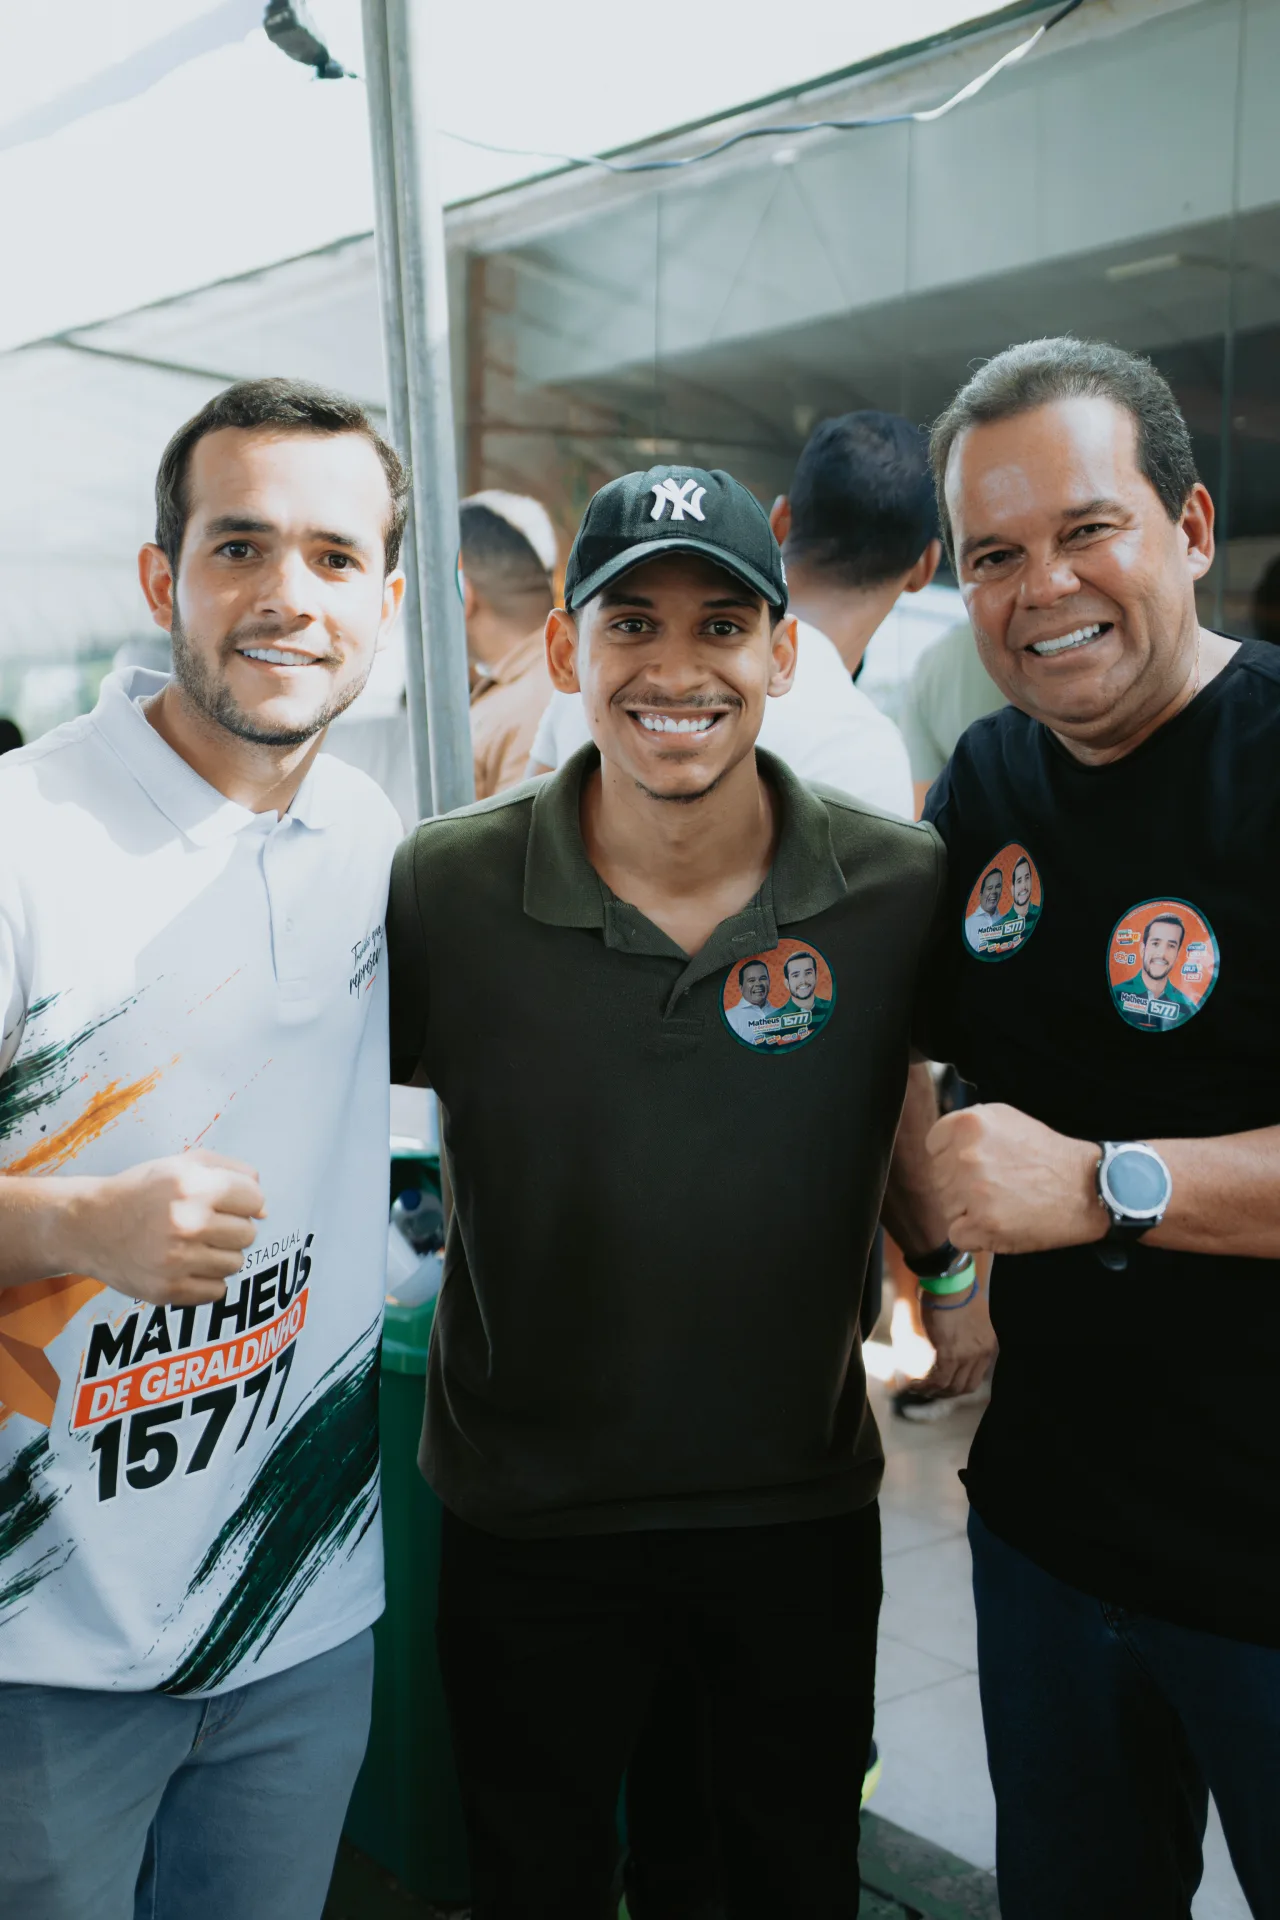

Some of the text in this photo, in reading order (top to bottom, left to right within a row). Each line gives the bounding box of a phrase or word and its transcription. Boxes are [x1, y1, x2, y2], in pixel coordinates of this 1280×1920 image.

[650, 477, 707, 521] NY
[748, 1018, 780, 1027] Matheus
[239, 1228, 301, 1273] STADUAL
[84, 1233, 314, 1379] MATHEUS
[89, 1301, 301, 1420] DE GERALDINHO
[91, 1339, 297, 1502] 15777
